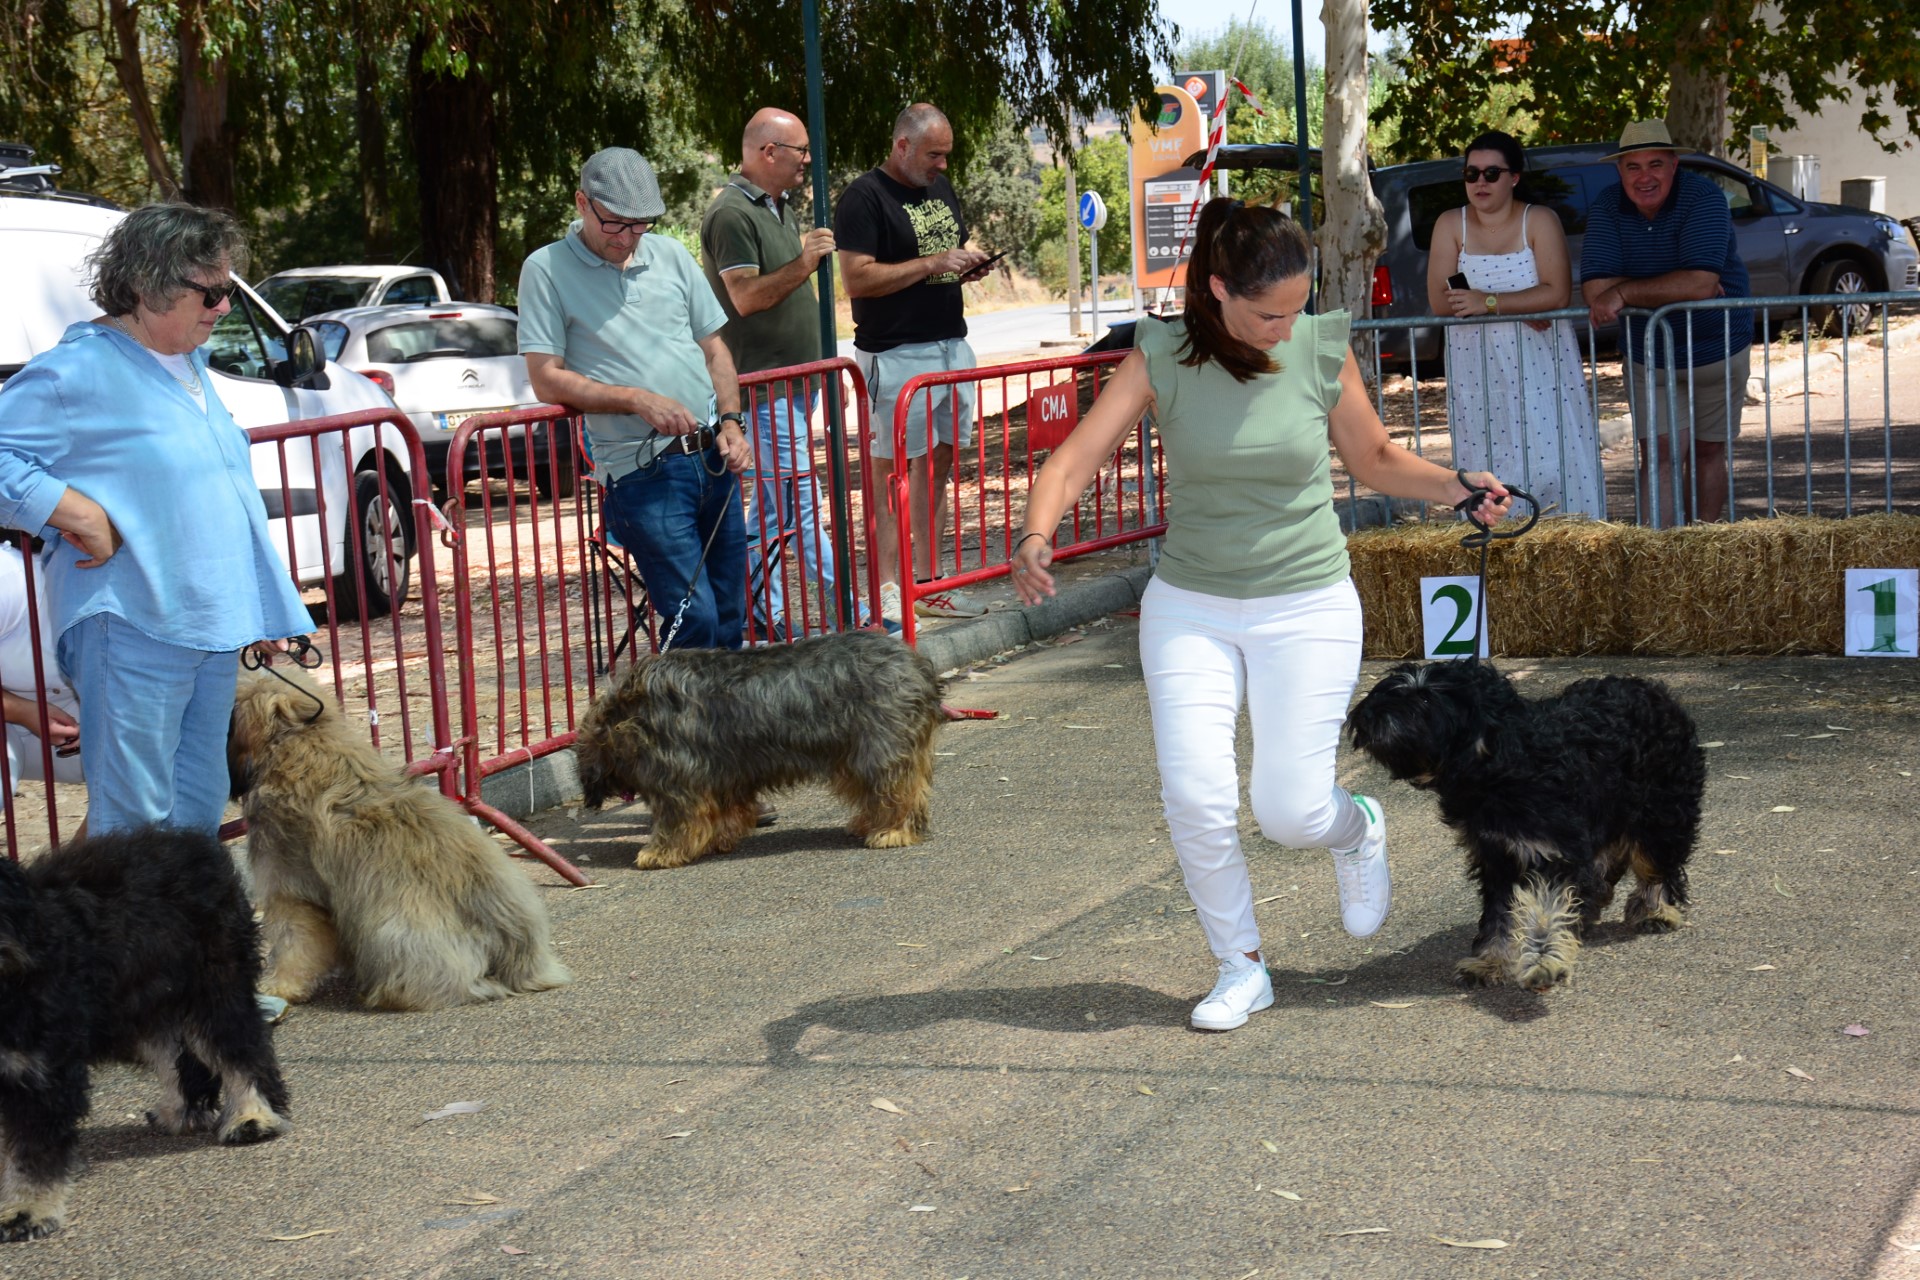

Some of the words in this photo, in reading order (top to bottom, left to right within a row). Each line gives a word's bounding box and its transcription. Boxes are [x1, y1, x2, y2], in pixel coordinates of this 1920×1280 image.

[1148, 138, 1184, 152] VMF
[1041, 394, 1068, 422] CMA
[1430, 584, 1476, 655] 2
[1857, 577, 1911, 653] 1
